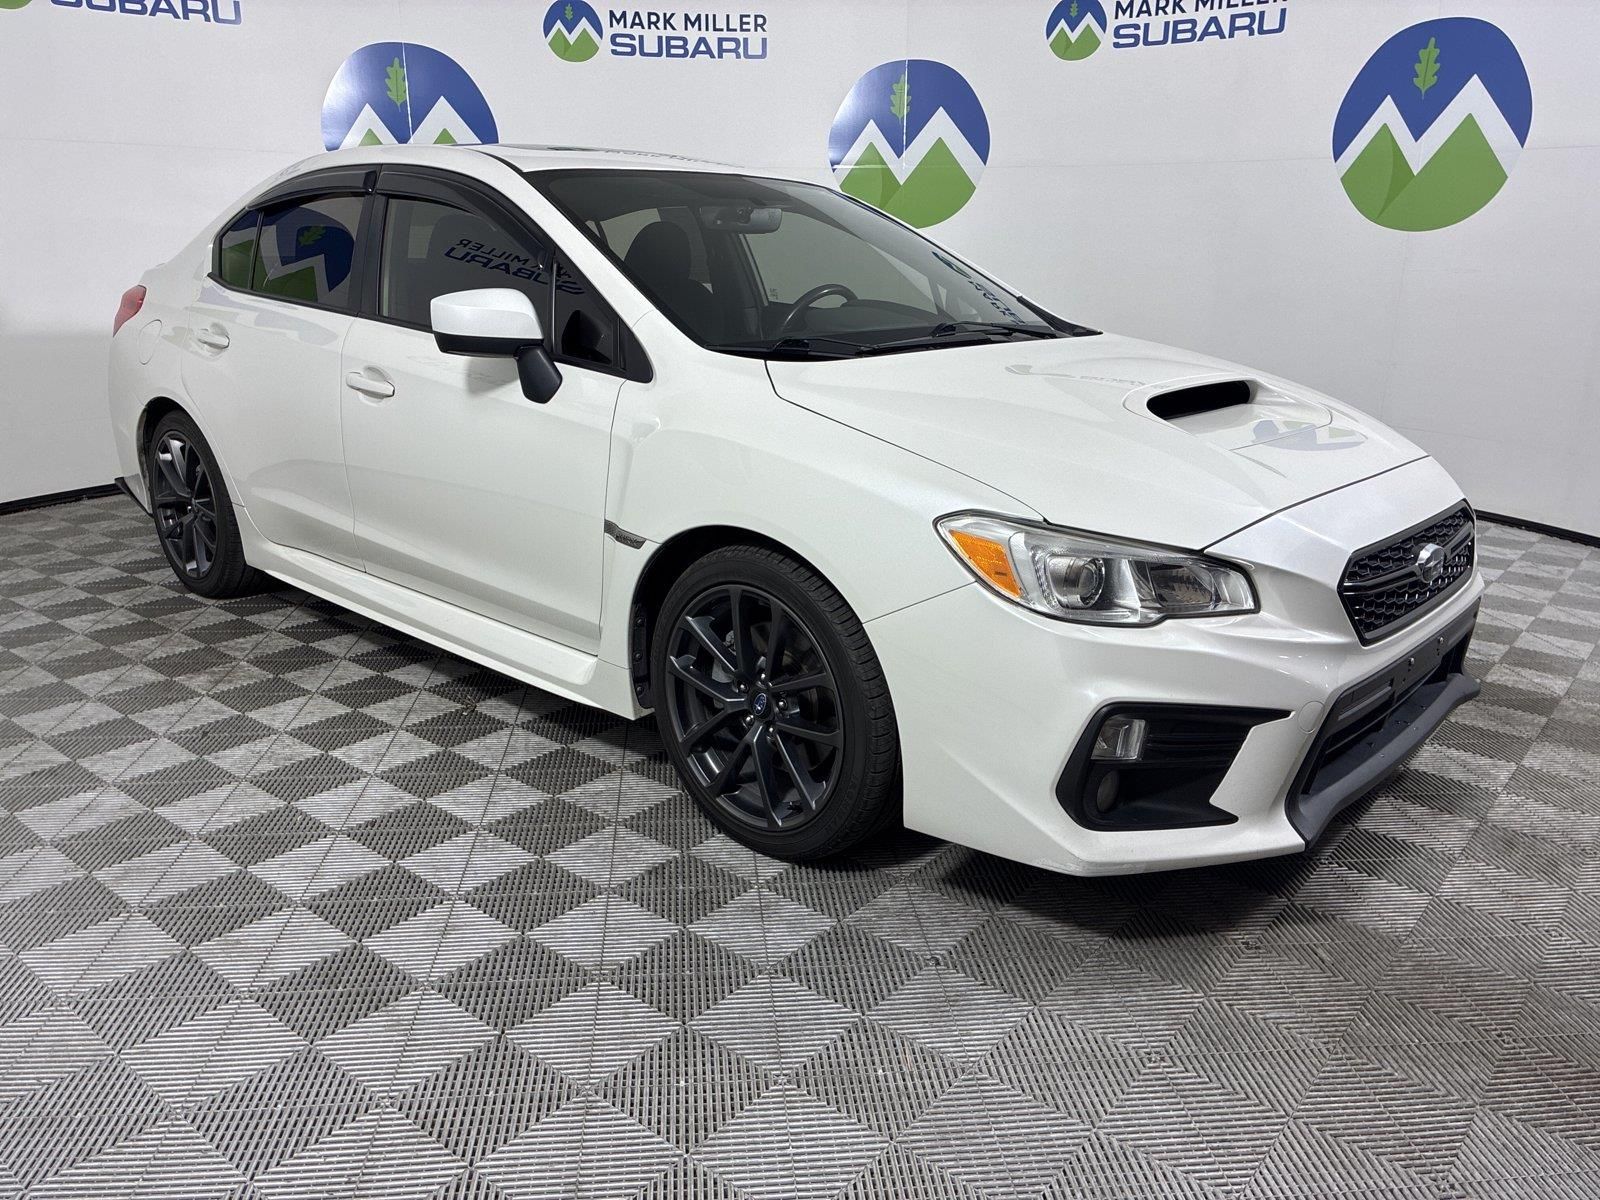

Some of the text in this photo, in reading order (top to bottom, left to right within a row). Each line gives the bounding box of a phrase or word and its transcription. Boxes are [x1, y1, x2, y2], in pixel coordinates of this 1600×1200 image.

[608, 9, 767, 32] MARK MILLER
[1114, 0, 1187, 20] MARK
[1112, 7, 1287, 49] SUBARU
[609, 33, 768, 60] SUBARU
